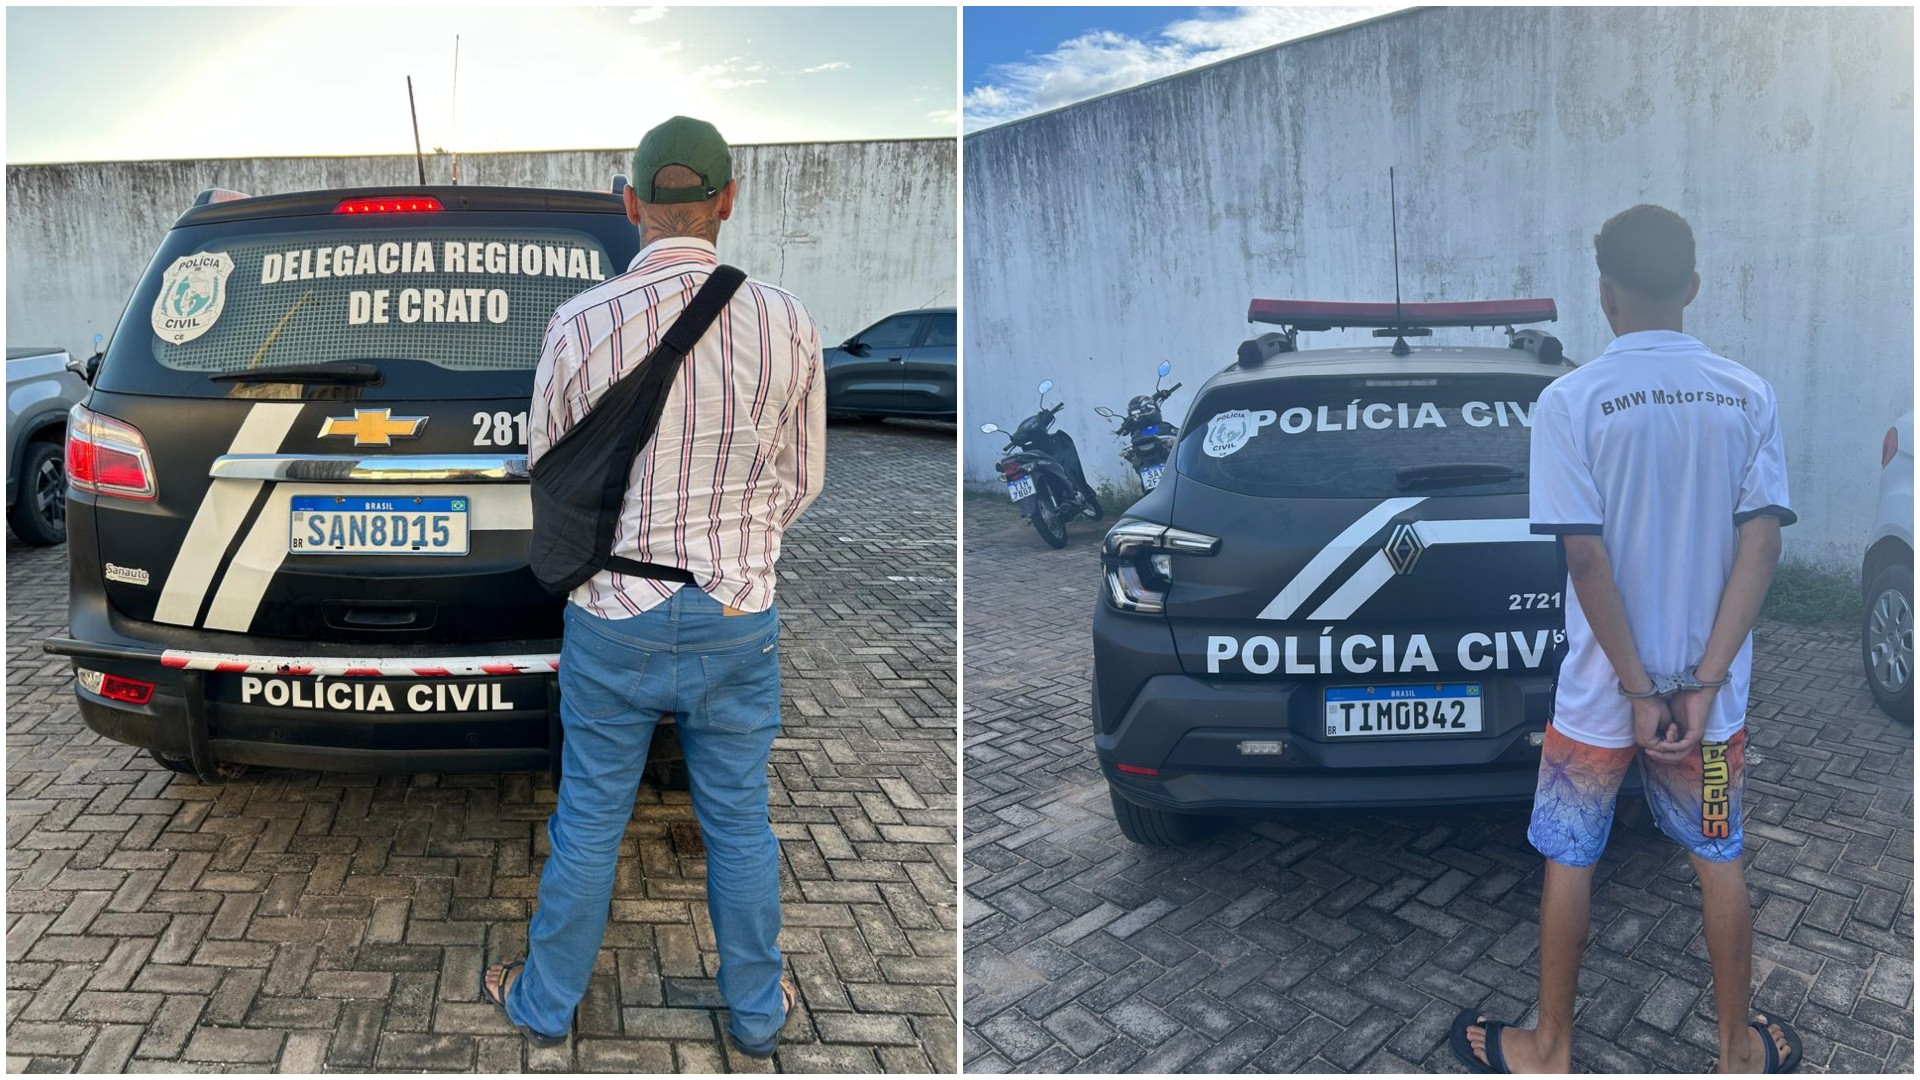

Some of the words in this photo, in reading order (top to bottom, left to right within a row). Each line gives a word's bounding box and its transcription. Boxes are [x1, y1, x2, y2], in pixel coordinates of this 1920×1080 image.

[261, 242, 435, 285] DELEGACIA
[443, 242, 605, 281] REGIONAL
[349, 290, 389, 325] DE
[399, 288, 509, 324] CRATO
[165, 318, 200, 329] CIVIL
[1600, 390, 1647, 416] BMW
[1651, 389, 1748, 412] Motorsport
[1249, 398, 1447, 437] POLÍCIA
[1461, 401, 1537, 428] CIV
[1212, 443, 1236, 451] CIVIL
[365, 502, 394, 510] BRASIL
[307, 514, 450, 547] SAN8D15
[293, 538, 303, 548] BR
[107, 564, 148, 579] Sanauto
[1508, 592, 1561, 610] 2721
[1207, 626, 1439, 675] POLÍCIA
[1456, 629, 1555, 671] CIV
[241, 675, 395, 712] POLÍCIA
[407, 683, 514, 712] CIVIL
[1391, 690, 1416, 698] BRASIL
[1327, 726, 1337, 735] BR
[1701, 741, 1730, 839] SEAWA
